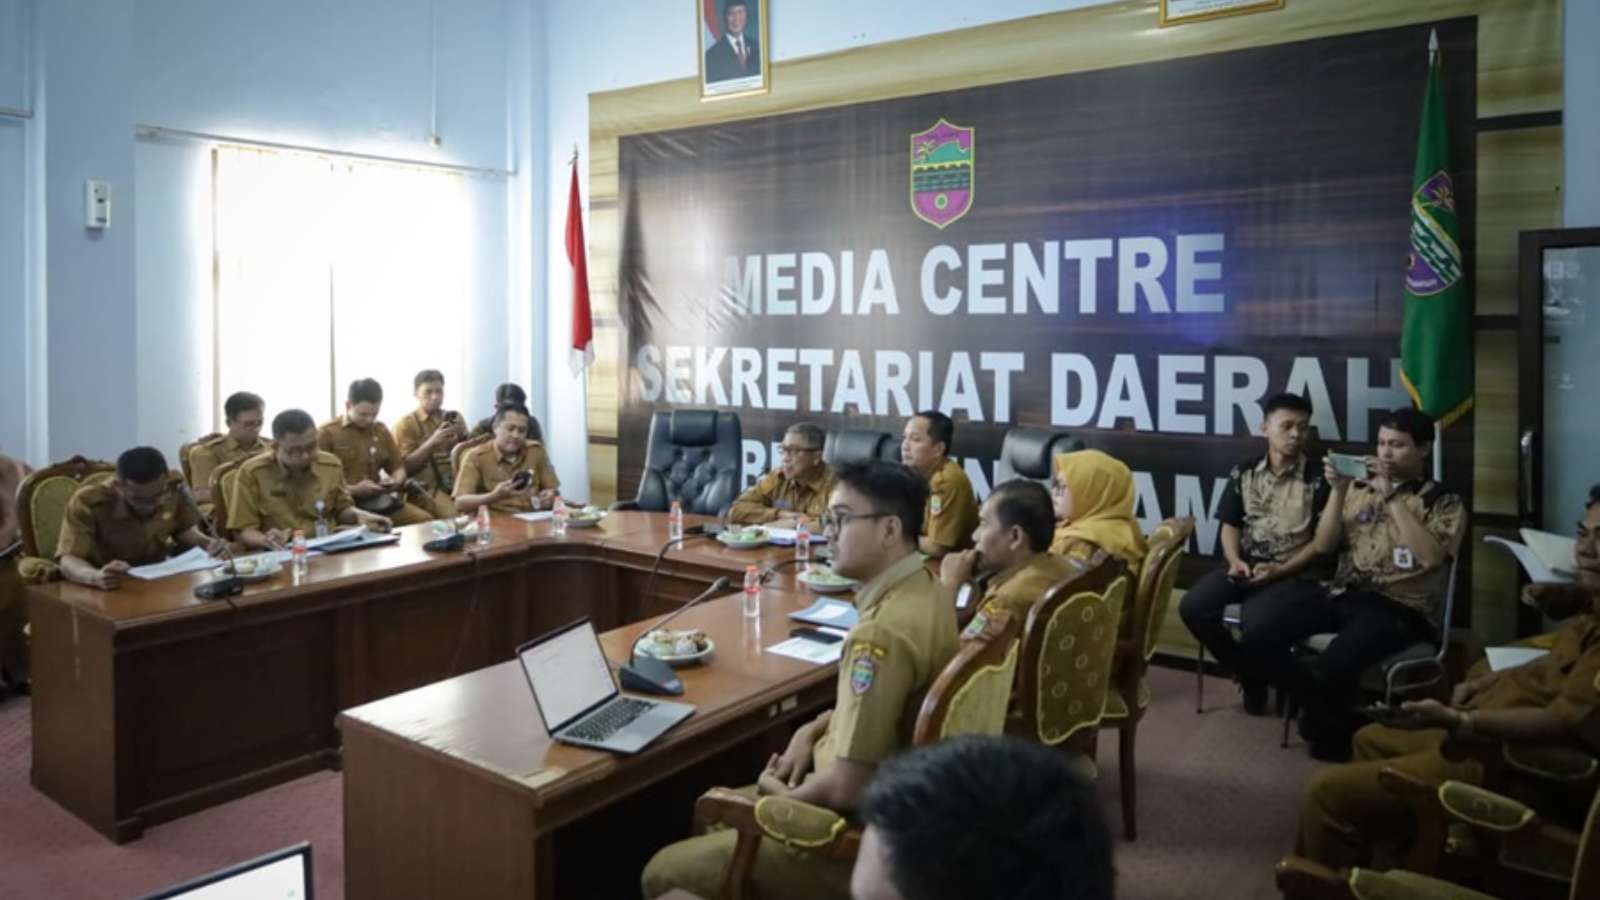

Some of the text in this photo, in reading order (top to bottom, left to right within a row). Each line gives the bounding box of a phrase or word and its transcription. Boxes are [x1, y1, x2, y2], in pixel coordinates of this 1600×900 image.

[722, 233, 1225, 316] MEDIA CENTRE
[637, 344, 1413, 442] SEKRETARIAT DAERAH
